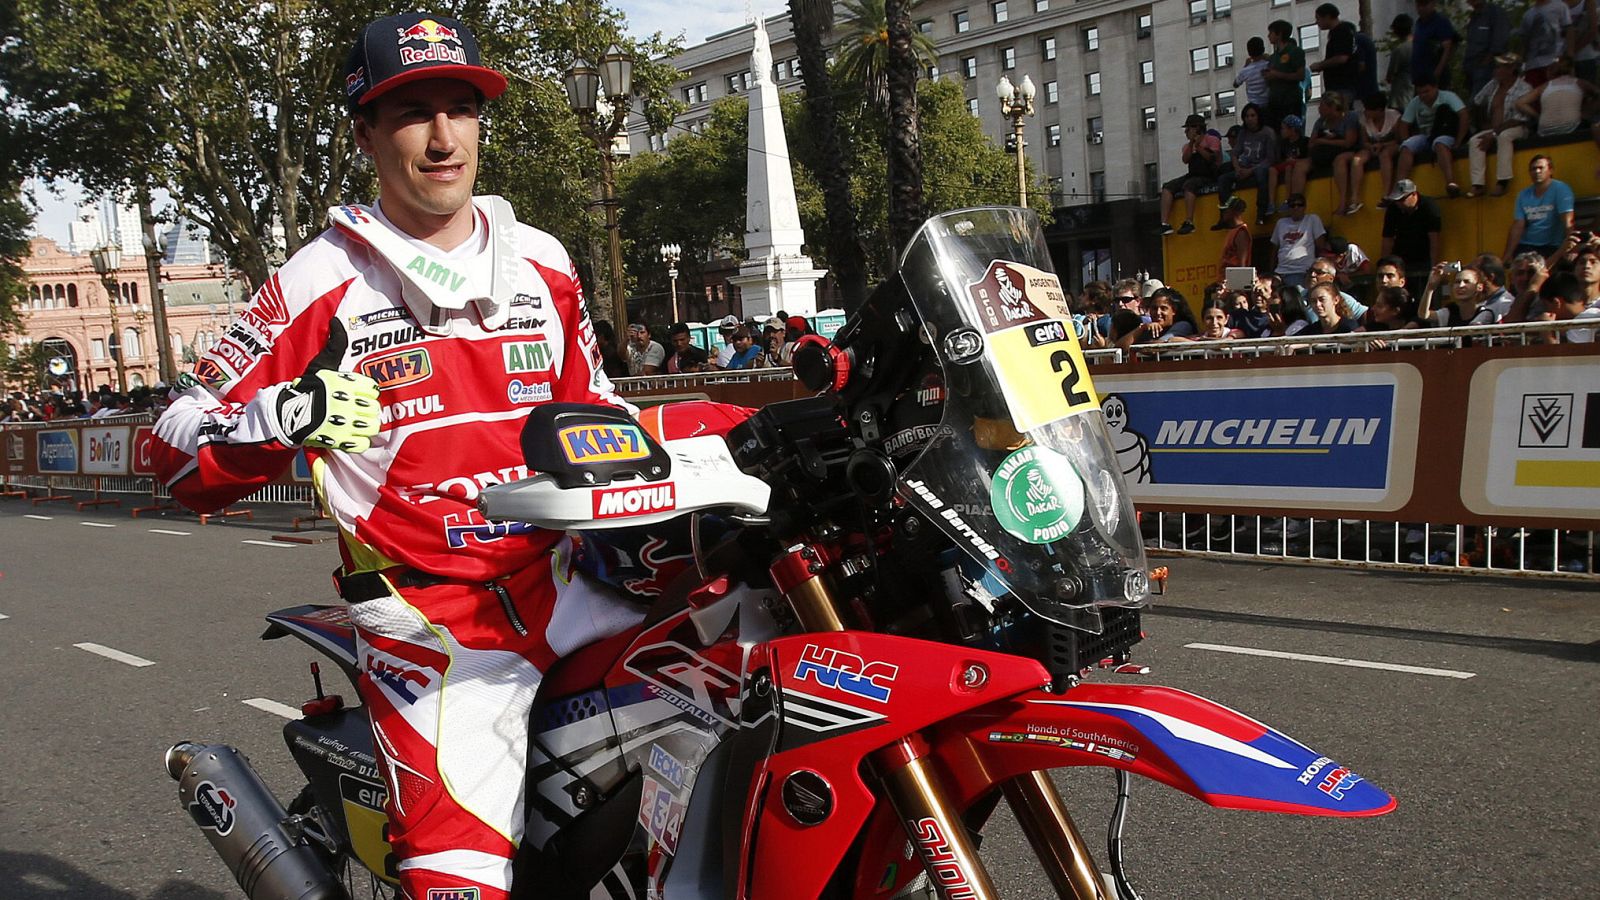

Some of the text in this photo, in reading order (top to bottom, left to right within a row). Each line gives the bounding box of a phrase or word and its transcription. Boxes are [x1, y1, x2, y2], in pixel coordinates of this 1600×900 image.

[401, 43, 467, 65] Red Bull
[406, 255, 466, 292] AMV
[978, 288, 999, 327] 2015
[1001, 301, 1035, 322] DAKAR
[351, 327, 425, 357] SHOWA
[1034, 325, 1056, 341] elf
[370, 354, 423, 383] KH-7
[1050, 350, 1091, 407] 2
[380, 394, 445, 425] MOTUL
[917, 387, 941, 406] rpm
[566, 429, 640, 459] KH-7
[884, 431, 914, 455] BANG
[1154, 417, 1381, 446] MICHELIN
[41, 440, 74, 464] Argentina
[90, 432, 120, 462] Bolivia
[998, 449, 1033, 480] DAKAR
[597, 482, 675, 515] MOTUL
[1026, 495, 1062, 516] DAKAR
[906, 479, 1000, 560] Joan Barreda
[1033, 519, 1070, 541] PODIO
[794, 644, 899, 703] HRC
[1027, 724, 1139, 753] Honda of SouthAmerica
